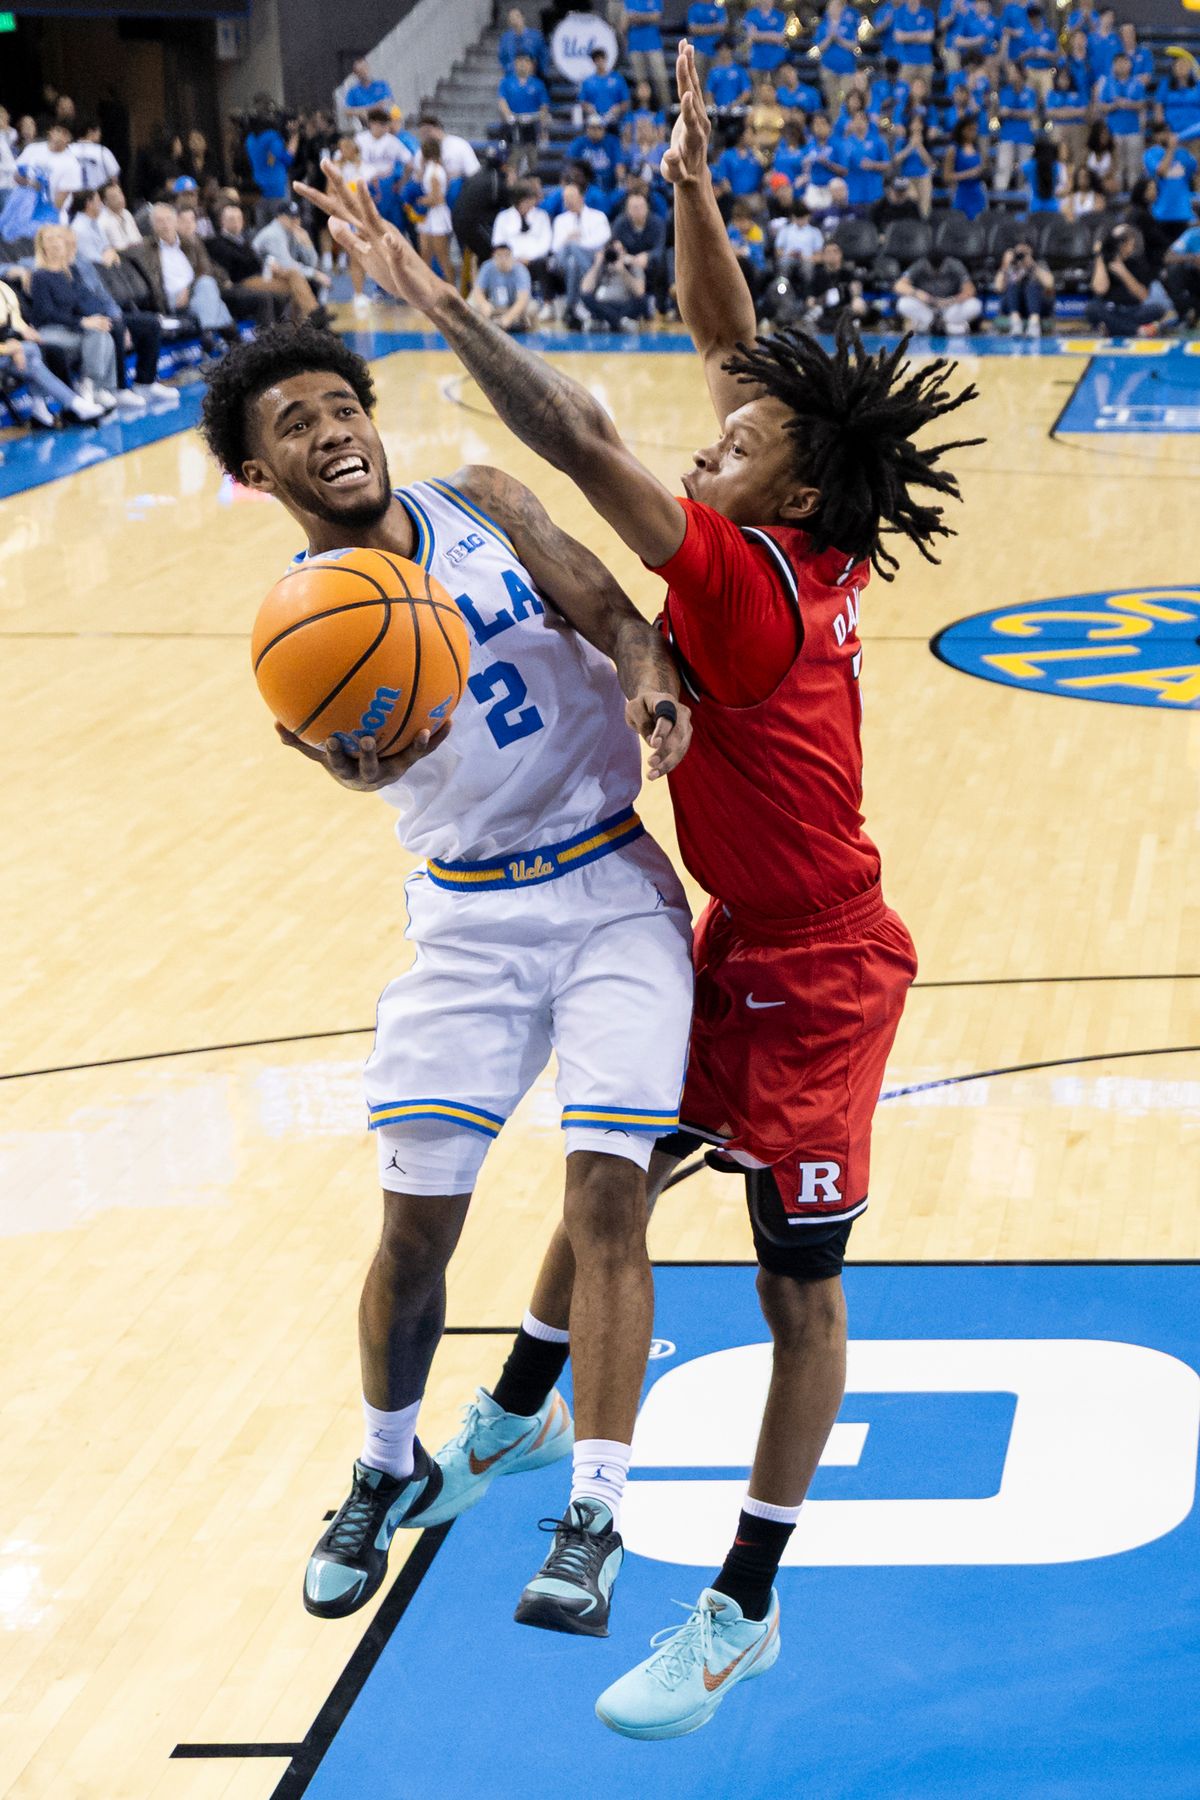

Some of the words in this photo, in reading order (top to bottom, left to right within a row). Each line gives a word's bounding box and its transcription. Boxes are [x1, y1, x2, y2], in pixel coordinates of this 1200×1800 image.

[562, 35, 597, 58] Ucl
[454, 568, 545, 647] LA
[466, 659, 545, 750] 2
[508, 854, 555, 882] Ucla
[797, 1161, 842, 1203] R
